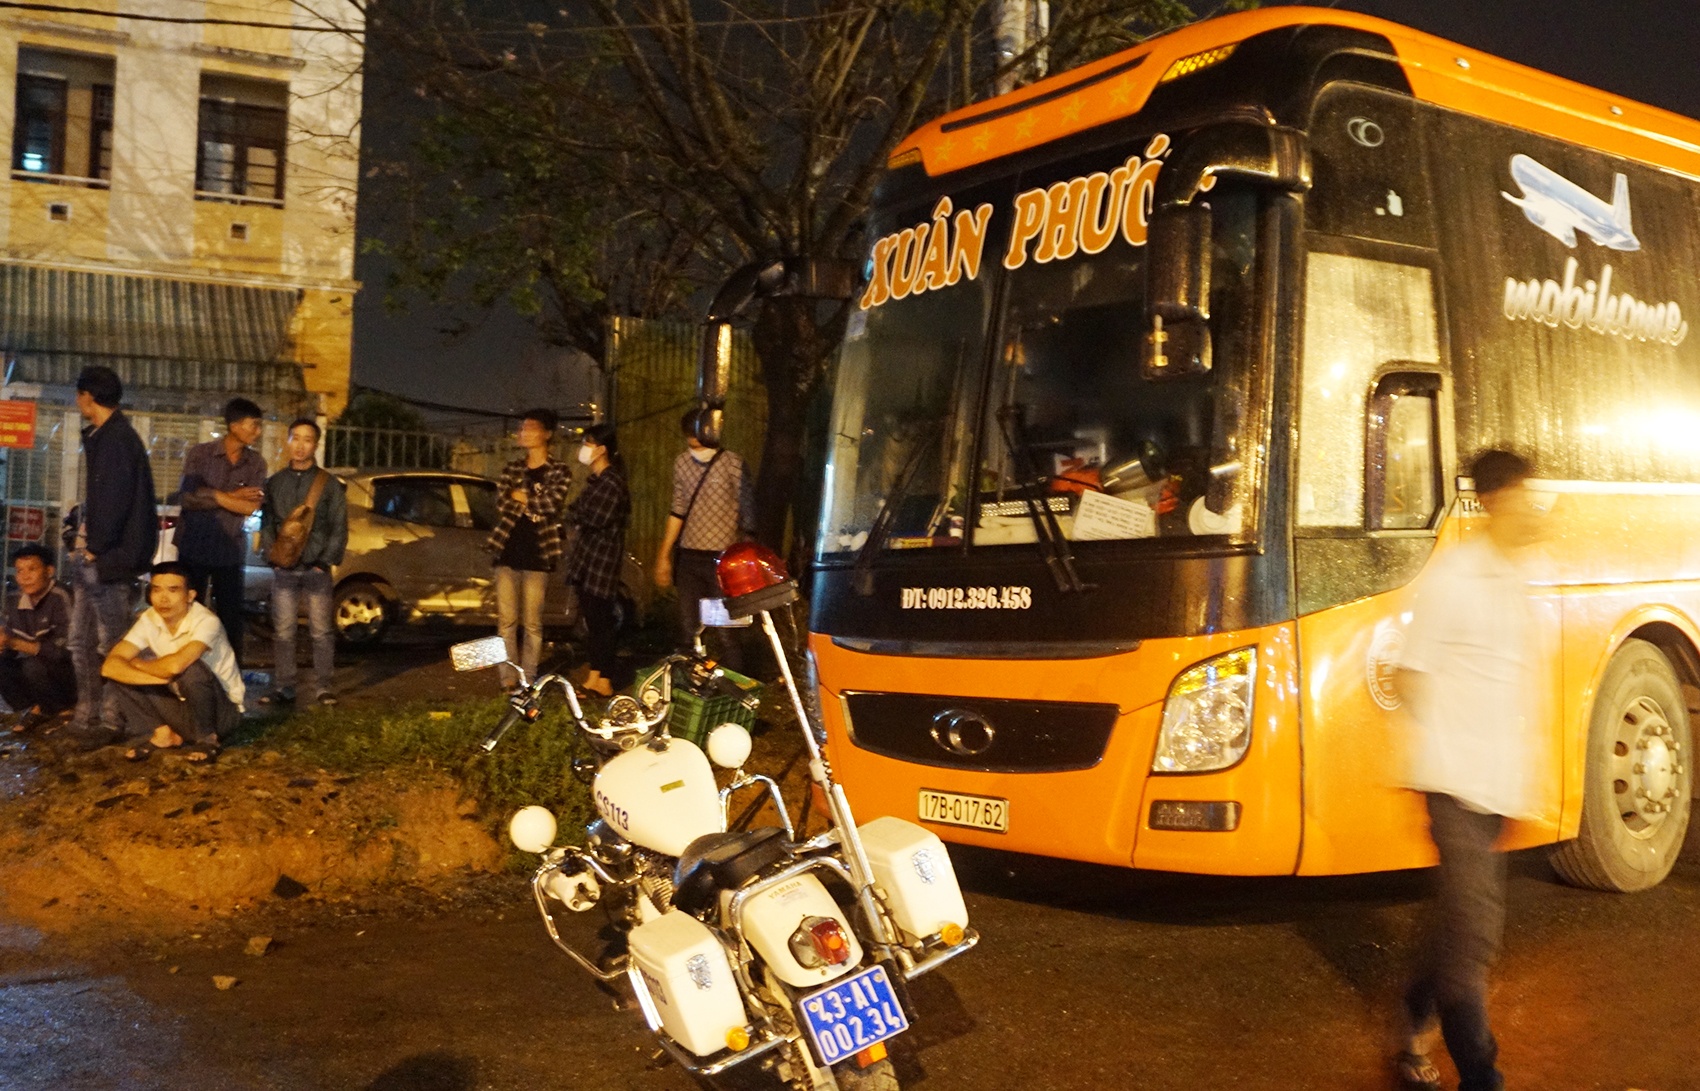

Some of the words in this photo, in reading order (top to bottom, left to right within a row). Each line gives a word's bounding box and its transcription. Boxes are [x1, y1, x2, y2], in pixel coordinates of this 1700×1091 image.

[860, 195, 993, 310] XUÂN
[1004, 133, 1173, 269] PHƯỚ
[1504, 256, 1688, 346] mobihome
[815, 975, 880, 1024] 43-A1
[819, 1001, 901, 1058] 002.34
